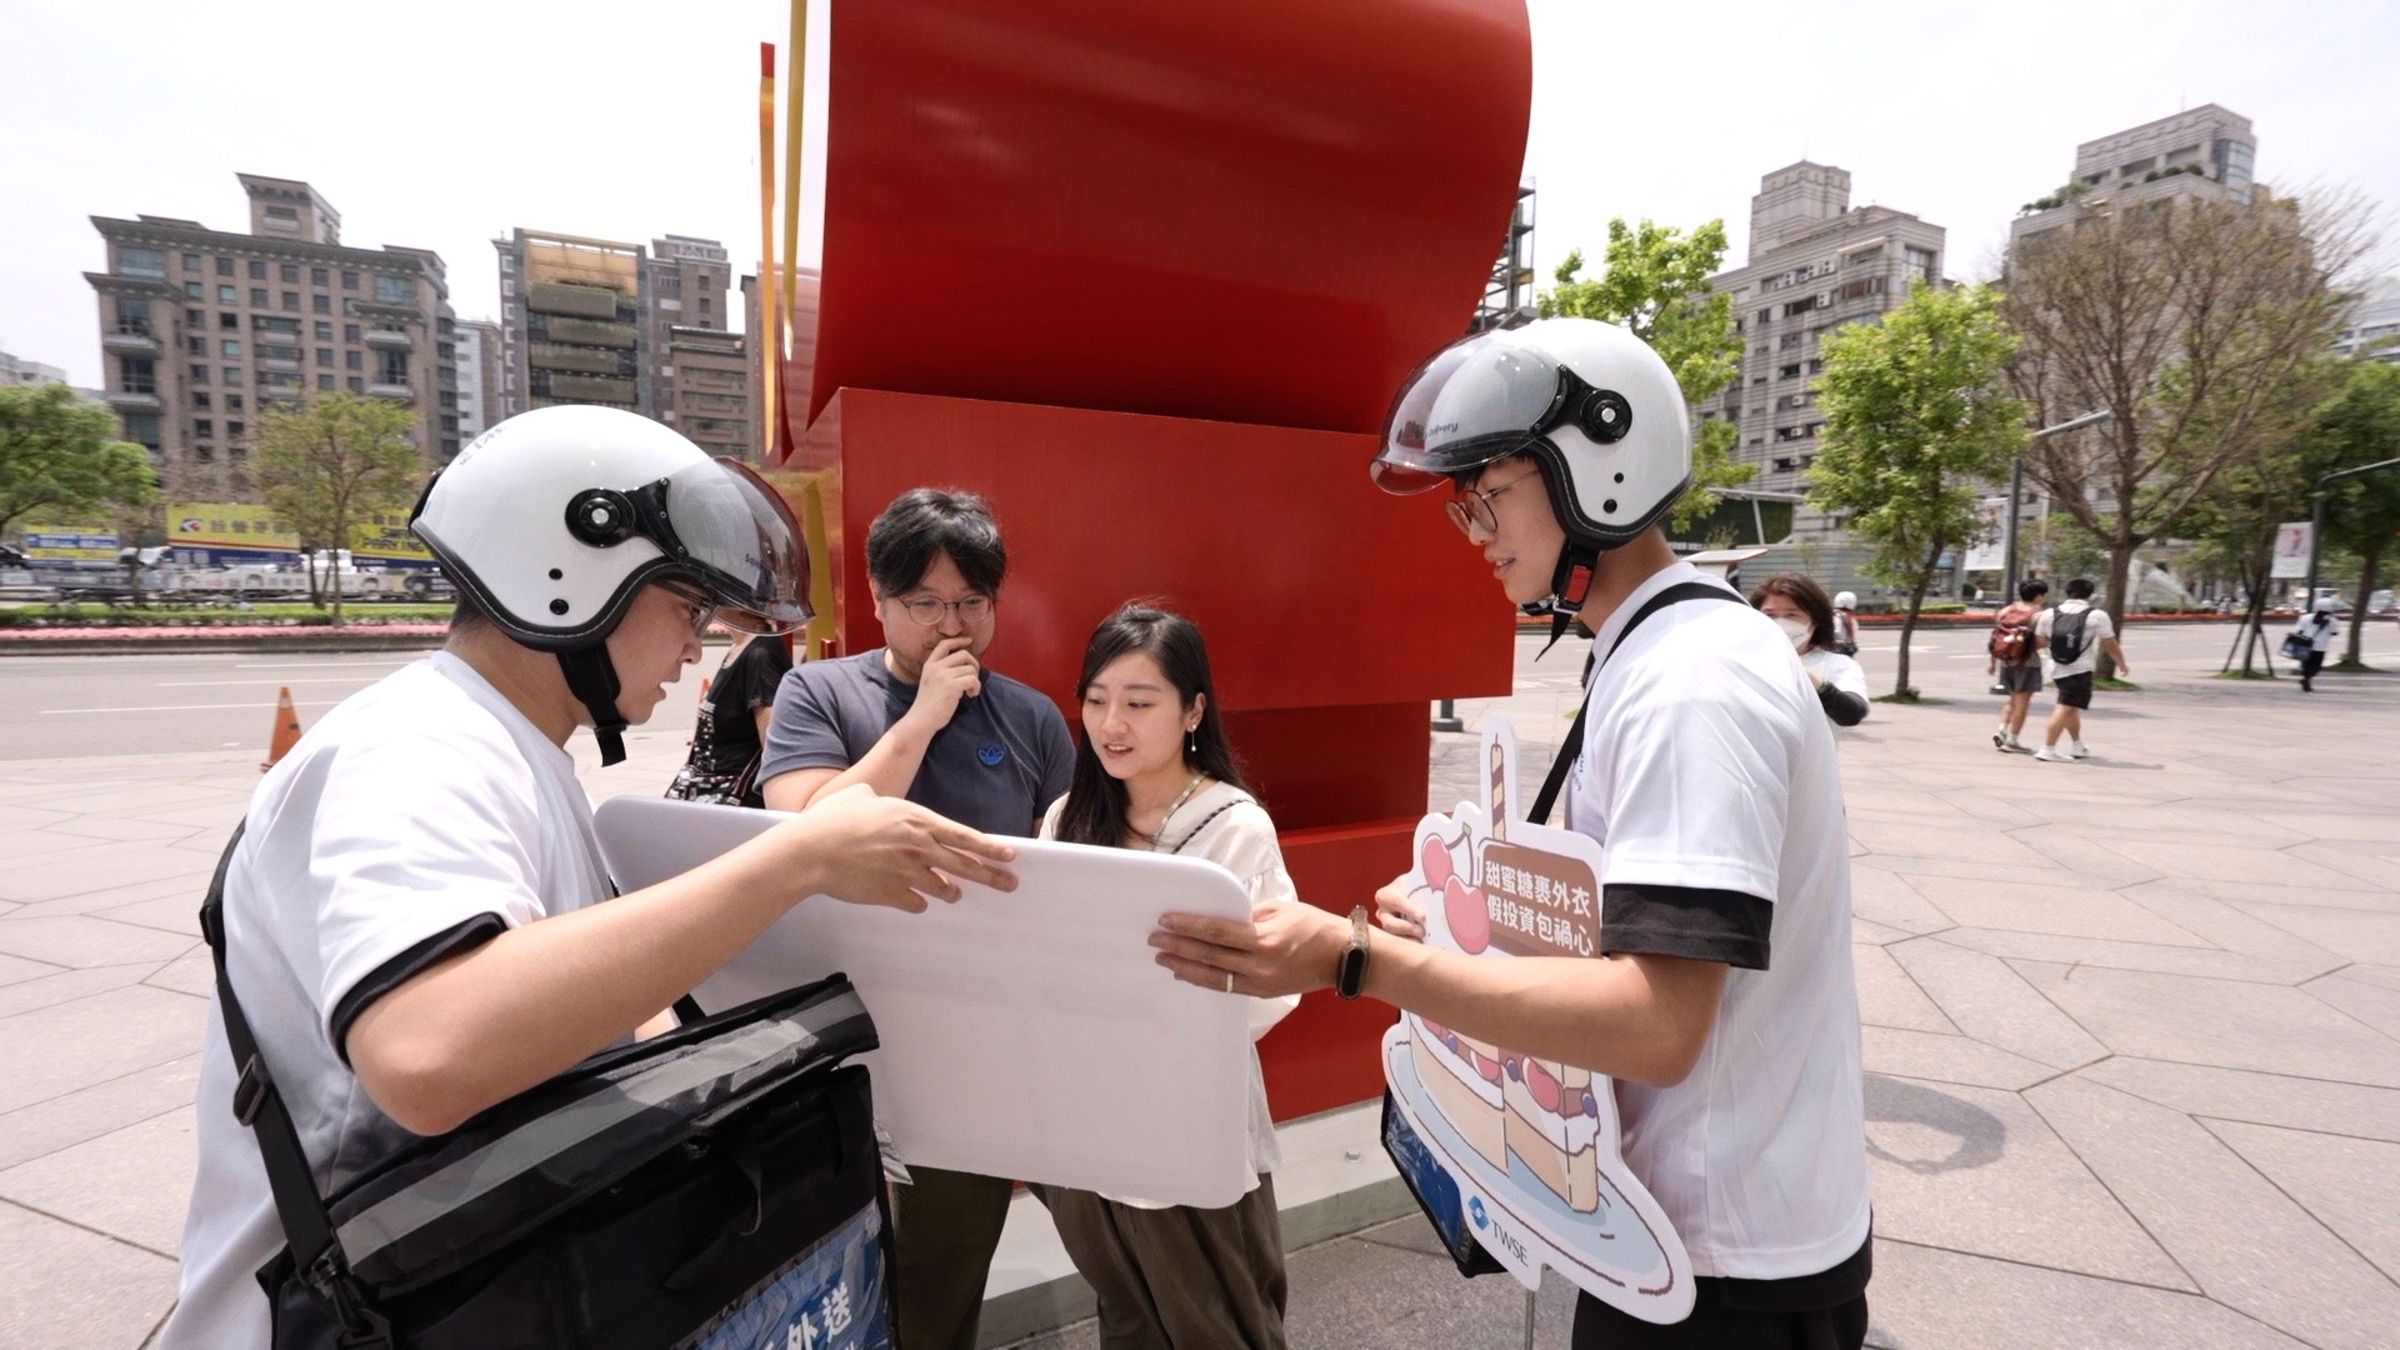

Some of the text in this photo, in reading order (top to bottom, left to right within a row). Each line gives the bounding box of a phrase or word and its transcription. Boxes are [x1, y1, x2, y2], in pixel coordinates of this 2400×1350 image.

[1485, 860, 1592, 918] 甜蜜糖裹外衣
[1487, 893, 1594, 957] 假投資包禍心
[1491, 1218, 1529, 1268] TWSE
